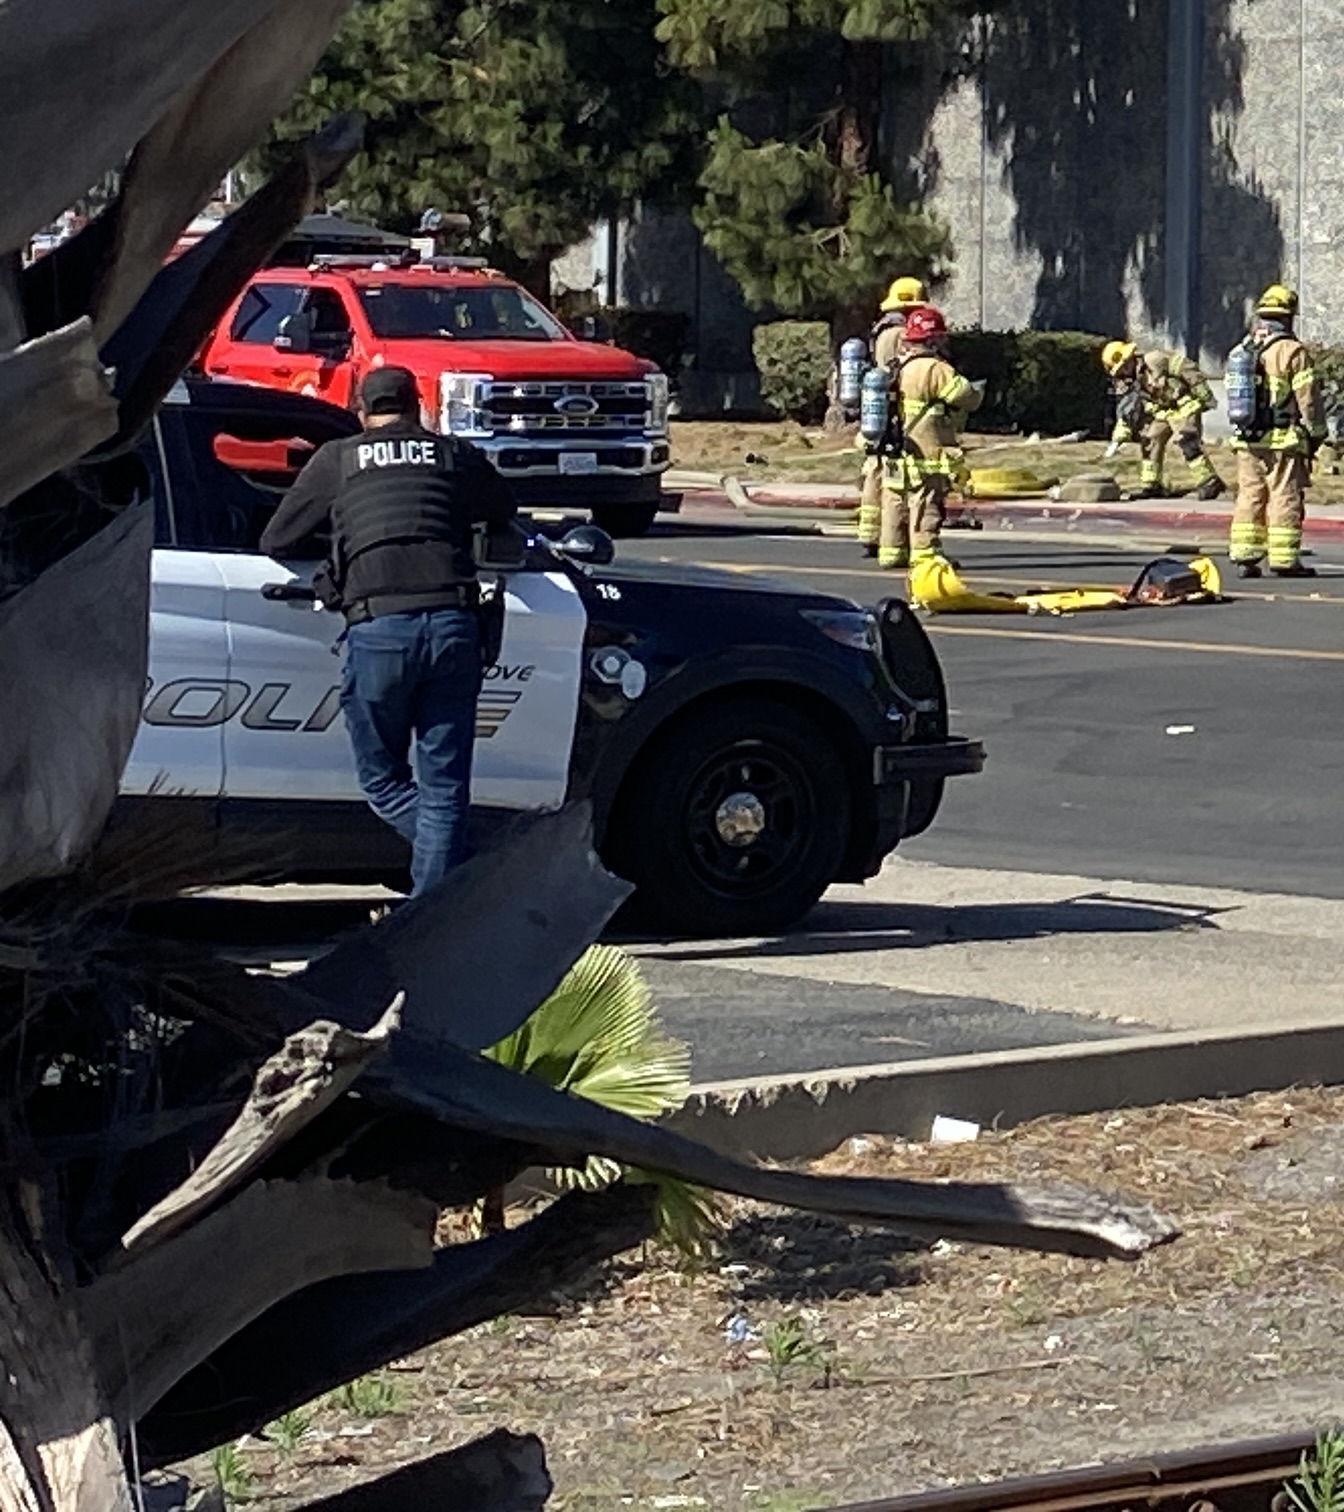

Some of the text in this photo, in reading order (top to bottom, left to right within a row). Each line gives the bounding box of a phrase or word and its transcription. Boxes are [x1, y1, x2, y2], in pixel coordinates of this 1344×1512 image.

[358, 440, 436, 470] POLICE
[482, 664, 536, 682] OVE
[144, 677, 522, 738] OLIE
